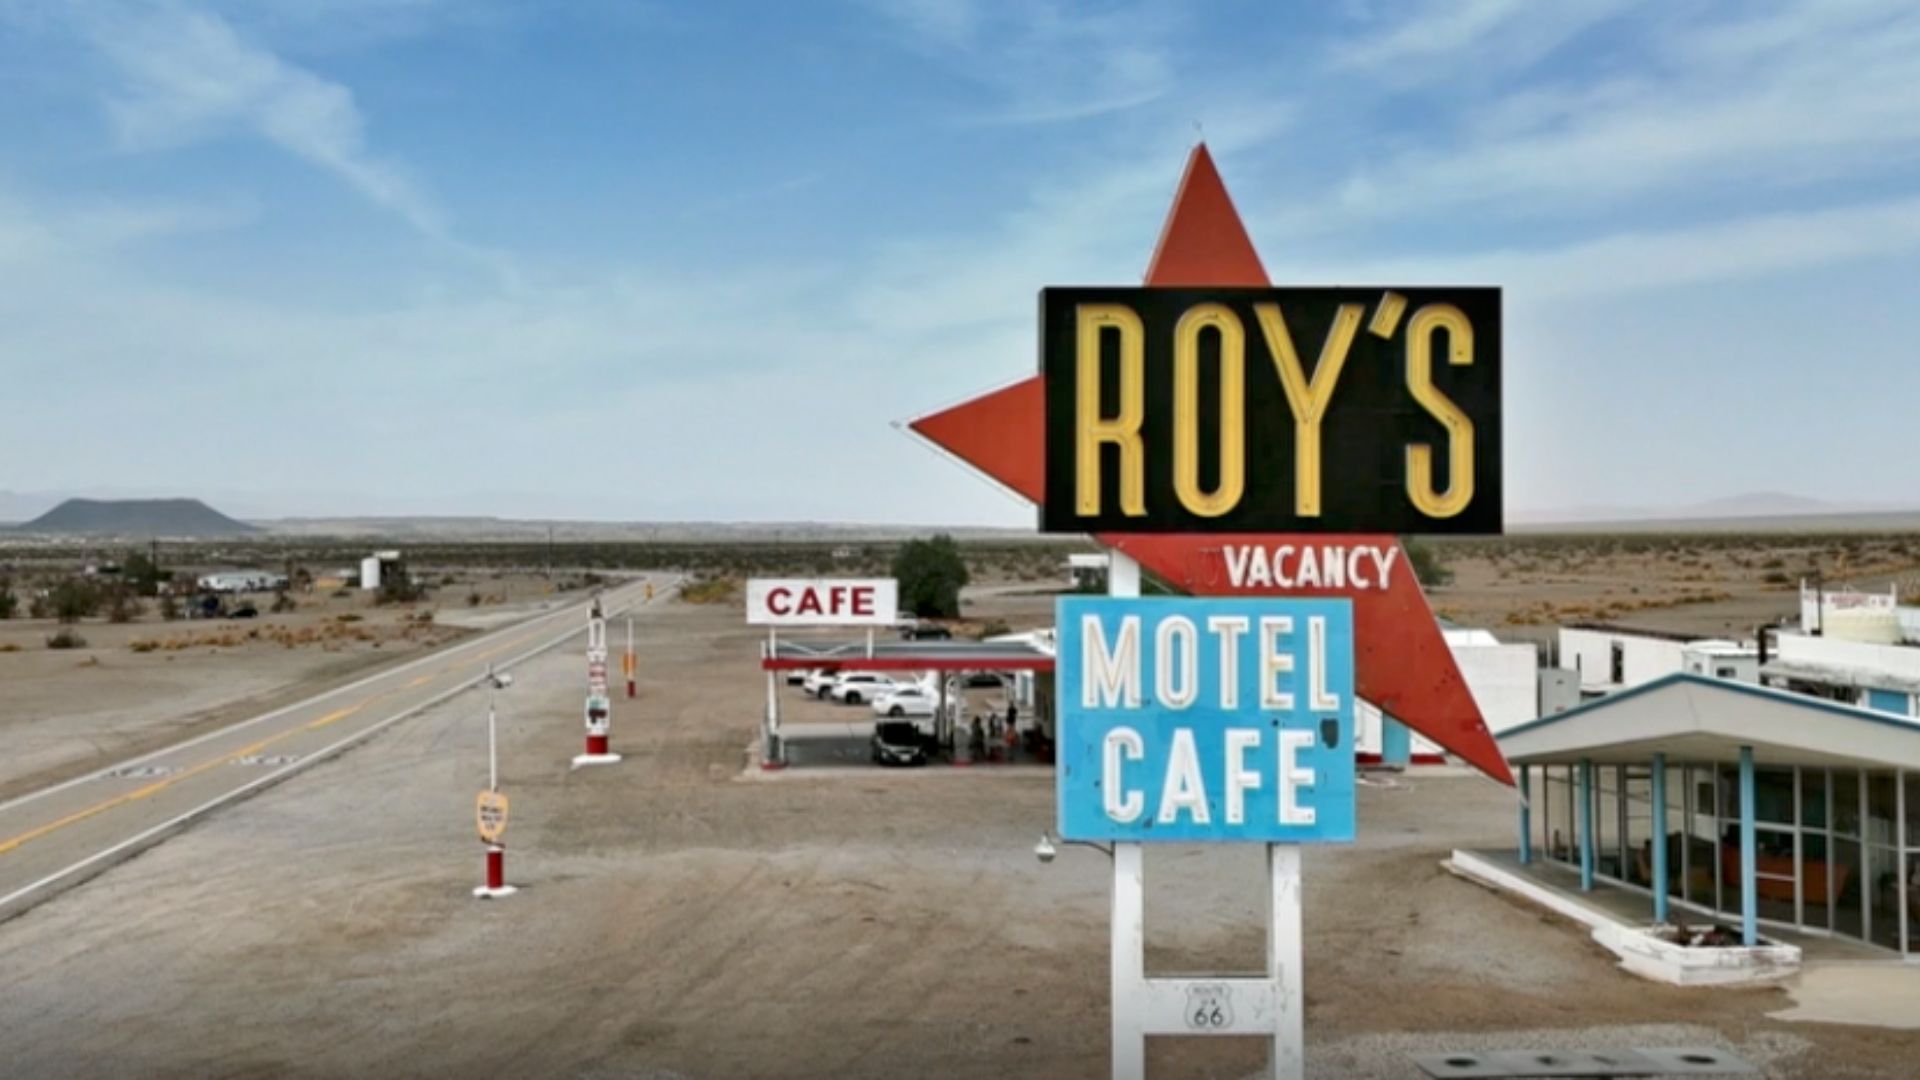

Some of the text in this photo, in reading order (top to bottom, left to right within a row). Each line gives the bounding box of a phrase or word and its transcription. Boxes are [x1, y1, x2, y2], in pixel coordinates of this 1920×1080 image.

[1075, 291, 1475, 518] ROY'S
[766, 587, 876, 616] CAFE
[1222, 545, 1399, 590] VACANCY
[1081, 614, 1341, 711] MOTEL
[1102, 726, 1316, 824] CAFE
[1194, 1006, 1224, 1027] 66
